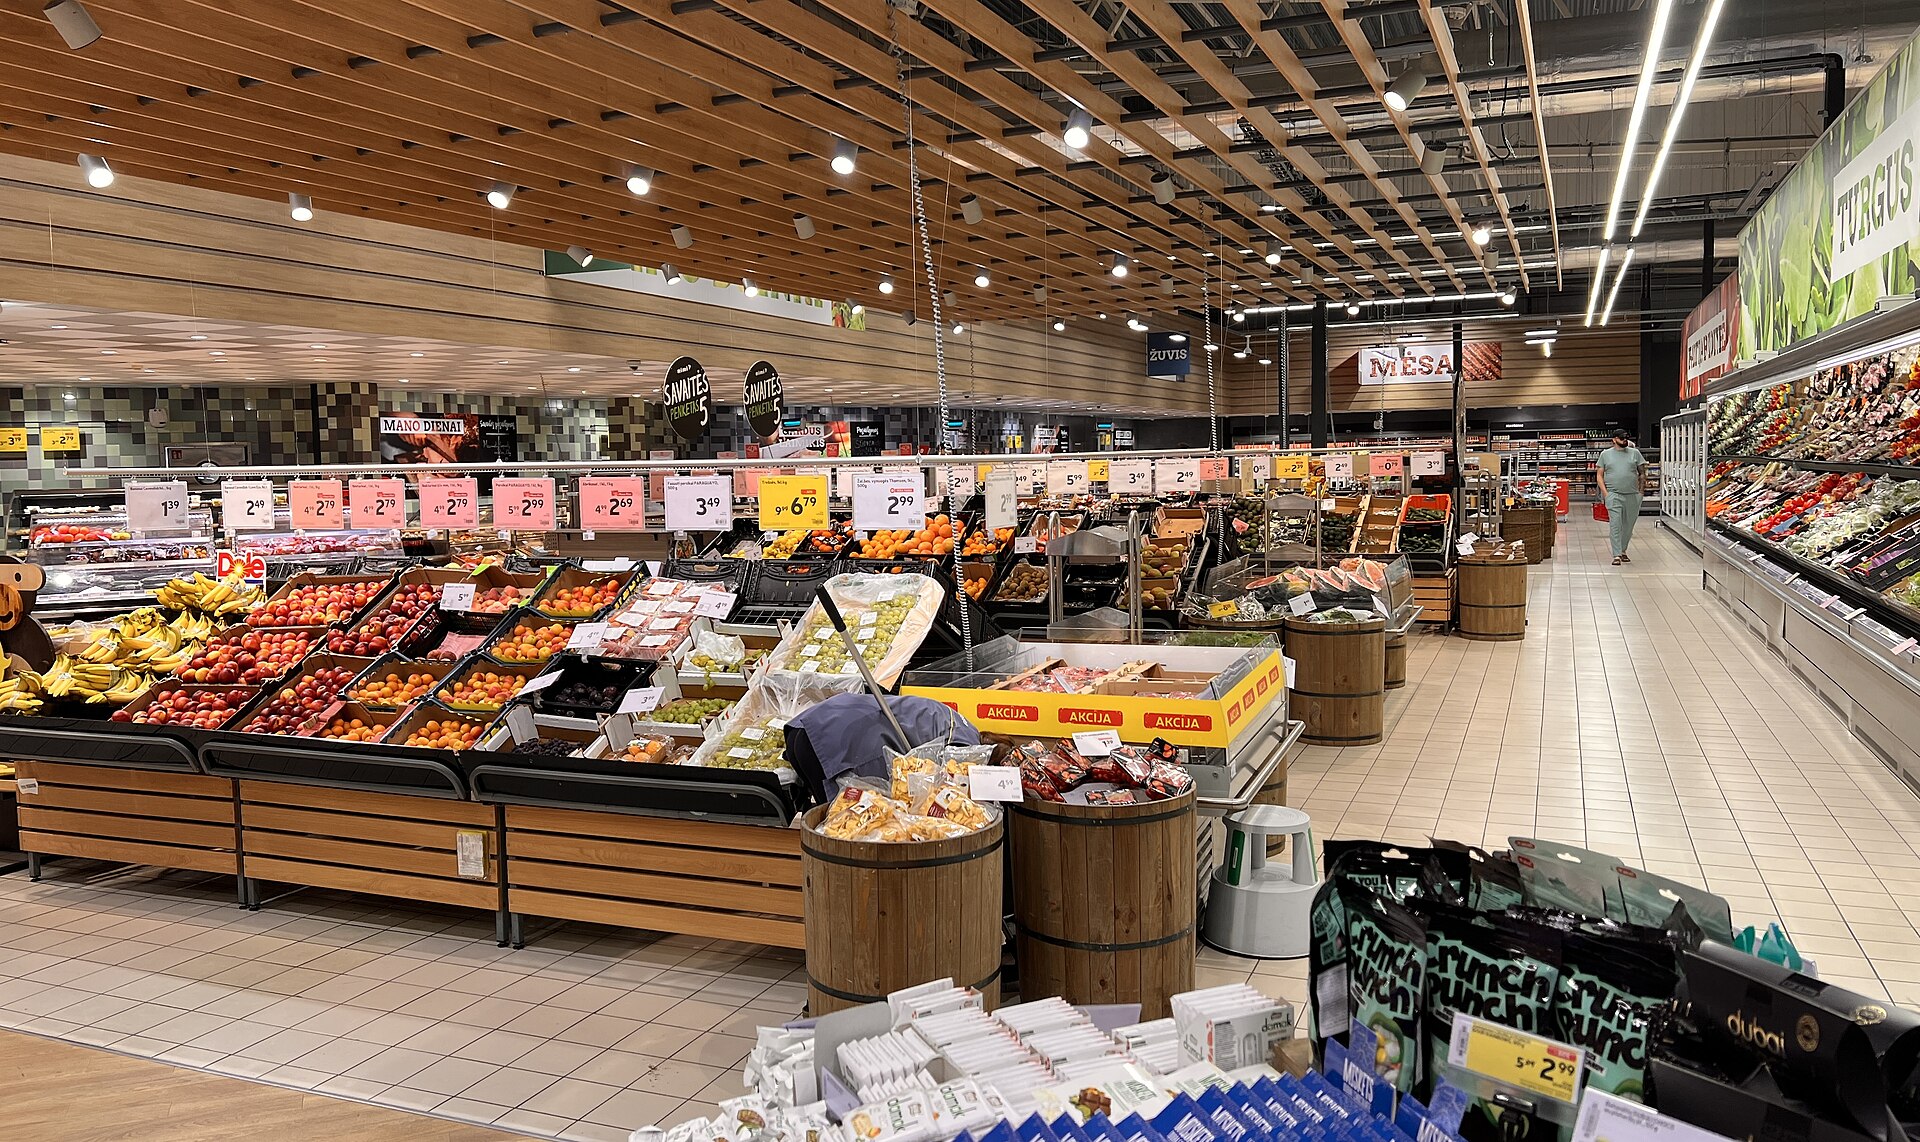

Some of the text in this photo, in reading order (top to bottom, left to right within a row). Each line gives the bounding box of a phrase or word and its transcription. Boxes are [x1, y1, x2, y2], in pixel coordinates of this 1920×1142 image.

[1837, 138, 1913, 253] TURGUS
[1149, 348, 1188, 361] ŽUVIS
[1369, 350, 1453, 378] MĖSA
[663, 369, 709, 406] SAVAITĖS
[744, 373, 782, 406] SAVAITĖS
[670, 395, 708, 427] PENKETAS 5
[773, 397, 781, 425] 5
[383, 419, 462, 432] MANO DIENAI
[161, 500, 180, 517] 139
[246, 499, 265, 516] 249
[315, 500, 335, 516] 279
[375, 499, 396, 516] 279
[446, 498, 468, 516] 279
[521, 499, 544, 517] 299
[609, 498, 633, 516] 269
[695, 497, 721, 516] 349
[790, 496, 817, 516] 679
[887, 495, 914, 515] 299
[987, 707, 1028, 719] AKCIJA
[1069, 711, 1112, 724] AKCIJA
[1155, 715, 1200, 729] AKCIJA
[1424, 932, 1552, 1005] Crunch
[1261, 1012, 1292, 1033] damak
[1726, 1009, 1785, 1056] dubai
[1539, 1057, 1576, 1081] 299
